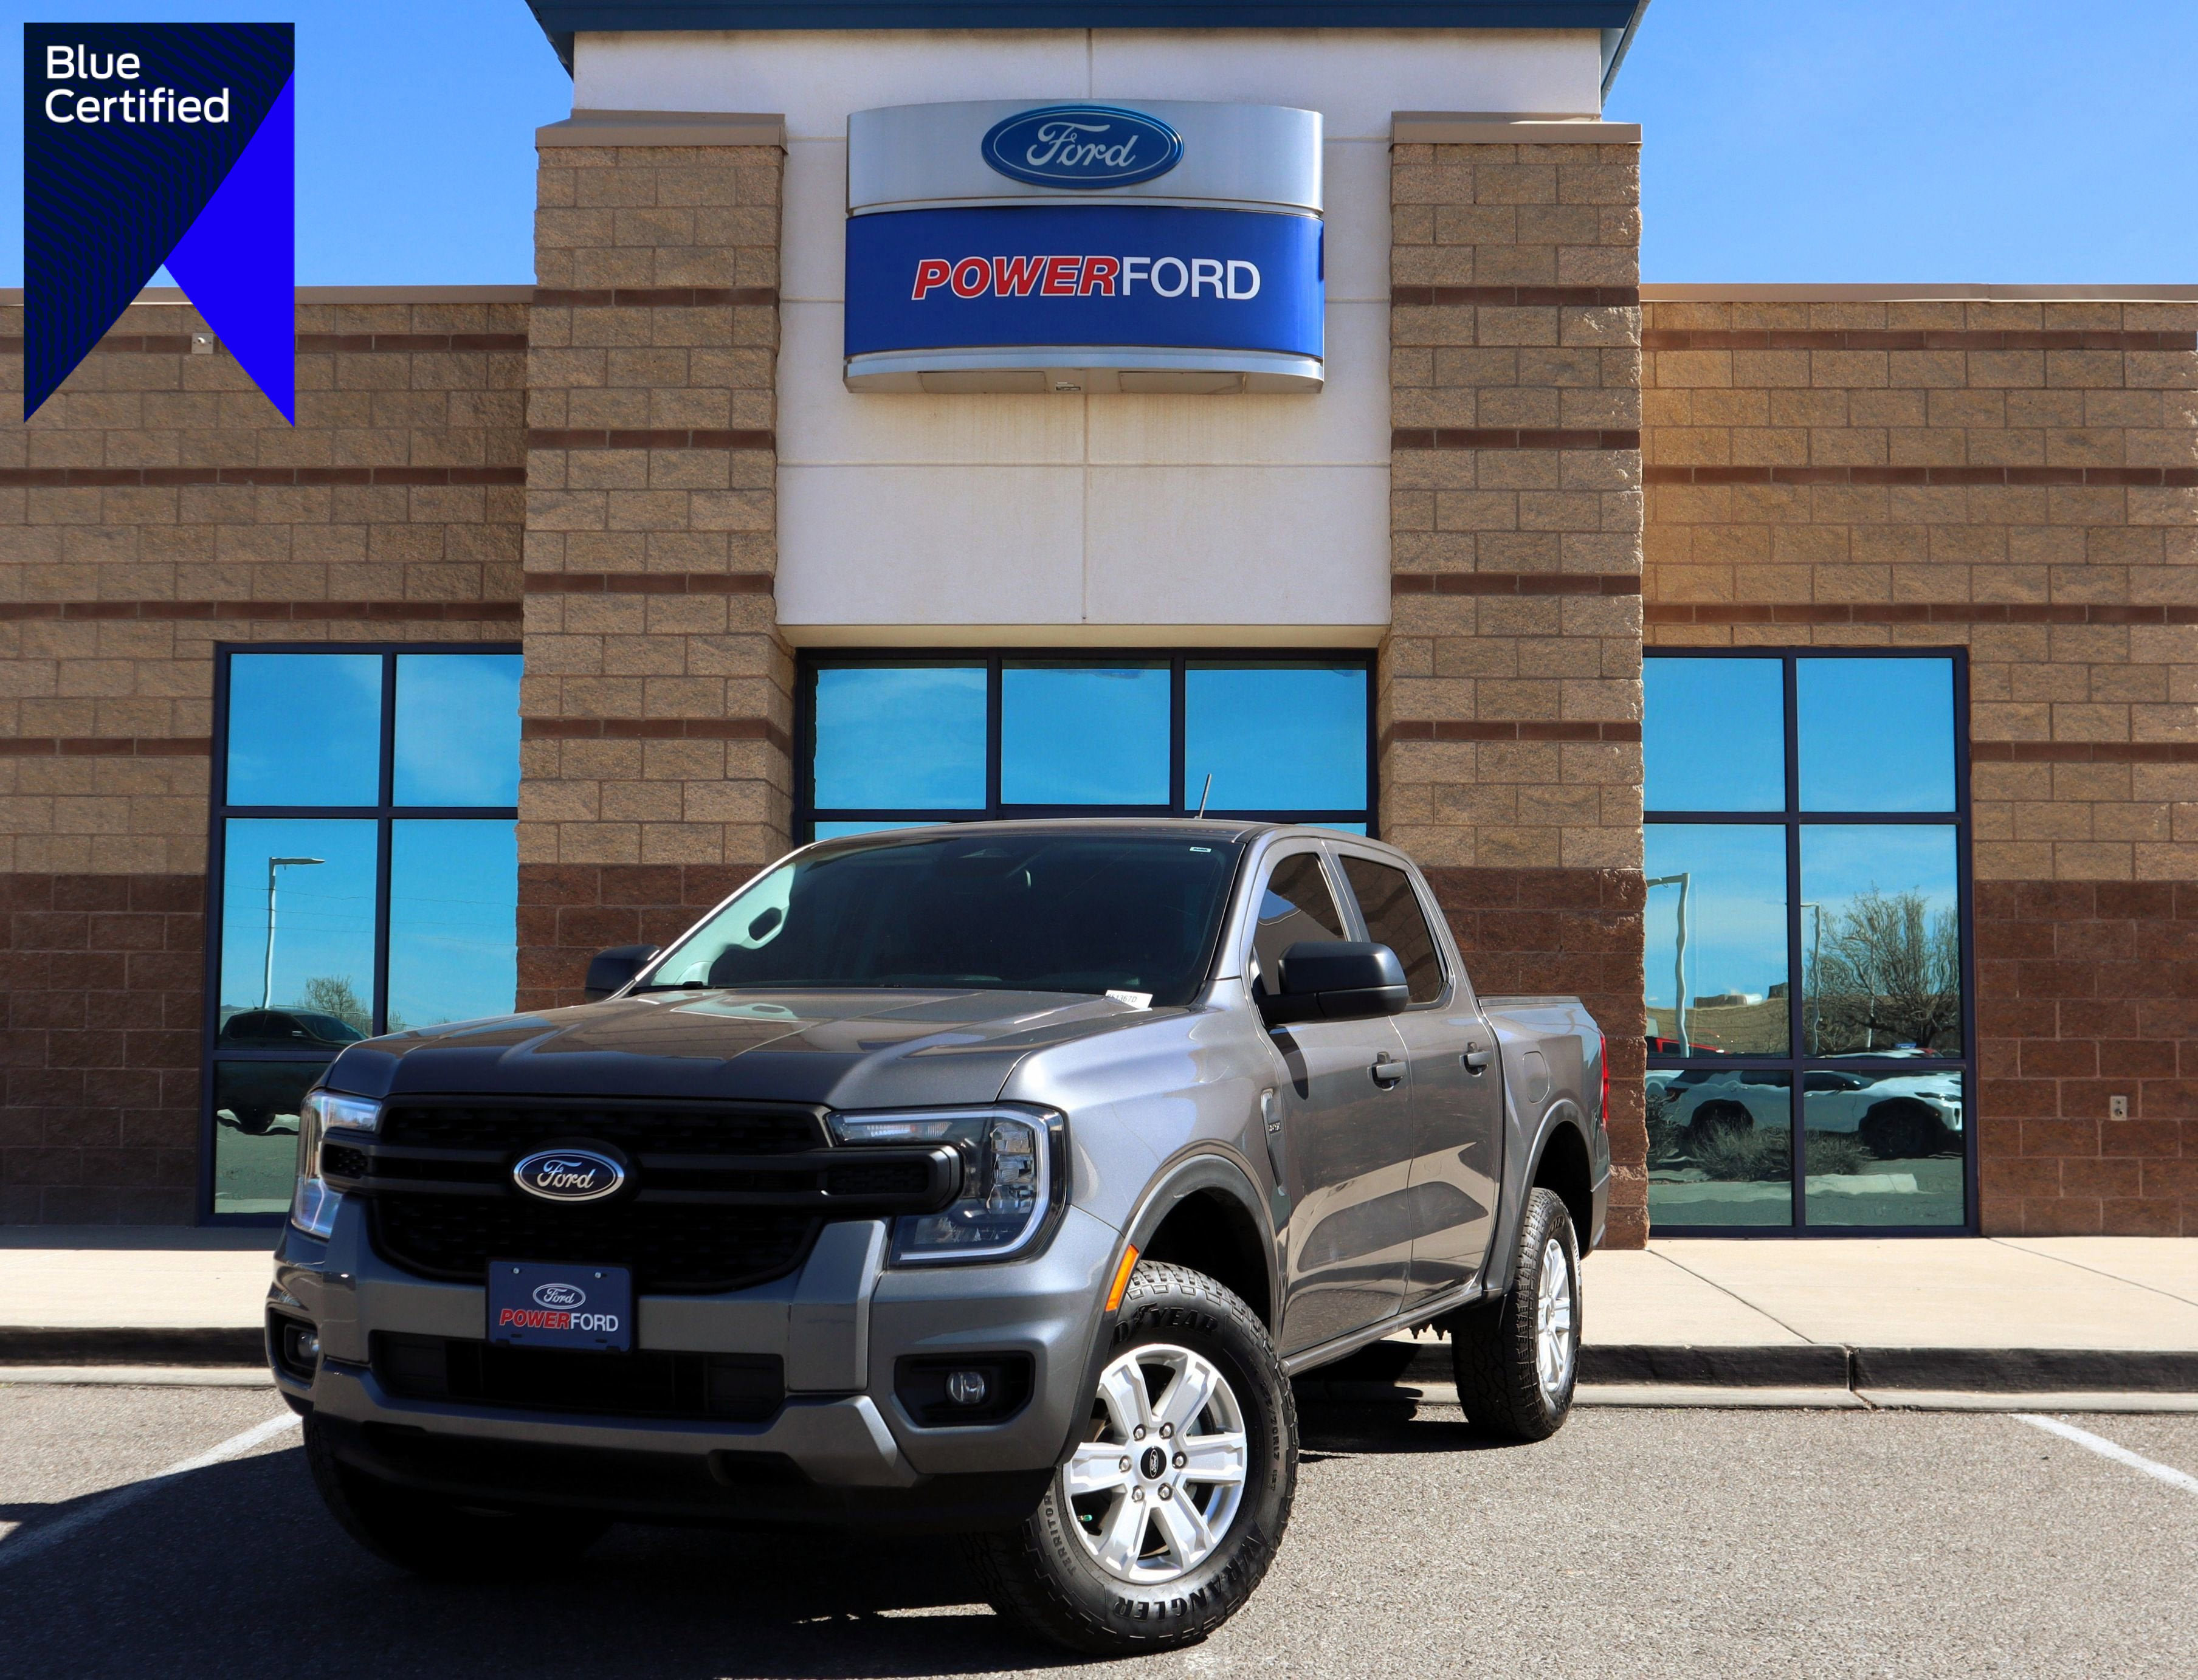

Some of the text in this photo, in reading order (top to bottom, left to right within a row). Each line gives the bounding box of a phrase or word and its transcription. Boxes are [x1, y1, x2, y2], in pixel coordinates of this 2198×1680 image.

[1026, 122, 1136, 167] Ford
[537, 1159, 597, 1188] Ford
[543, 1288, 576, 1304] Ford
[1043, 1485, 1077, 1577] TERRITOR
